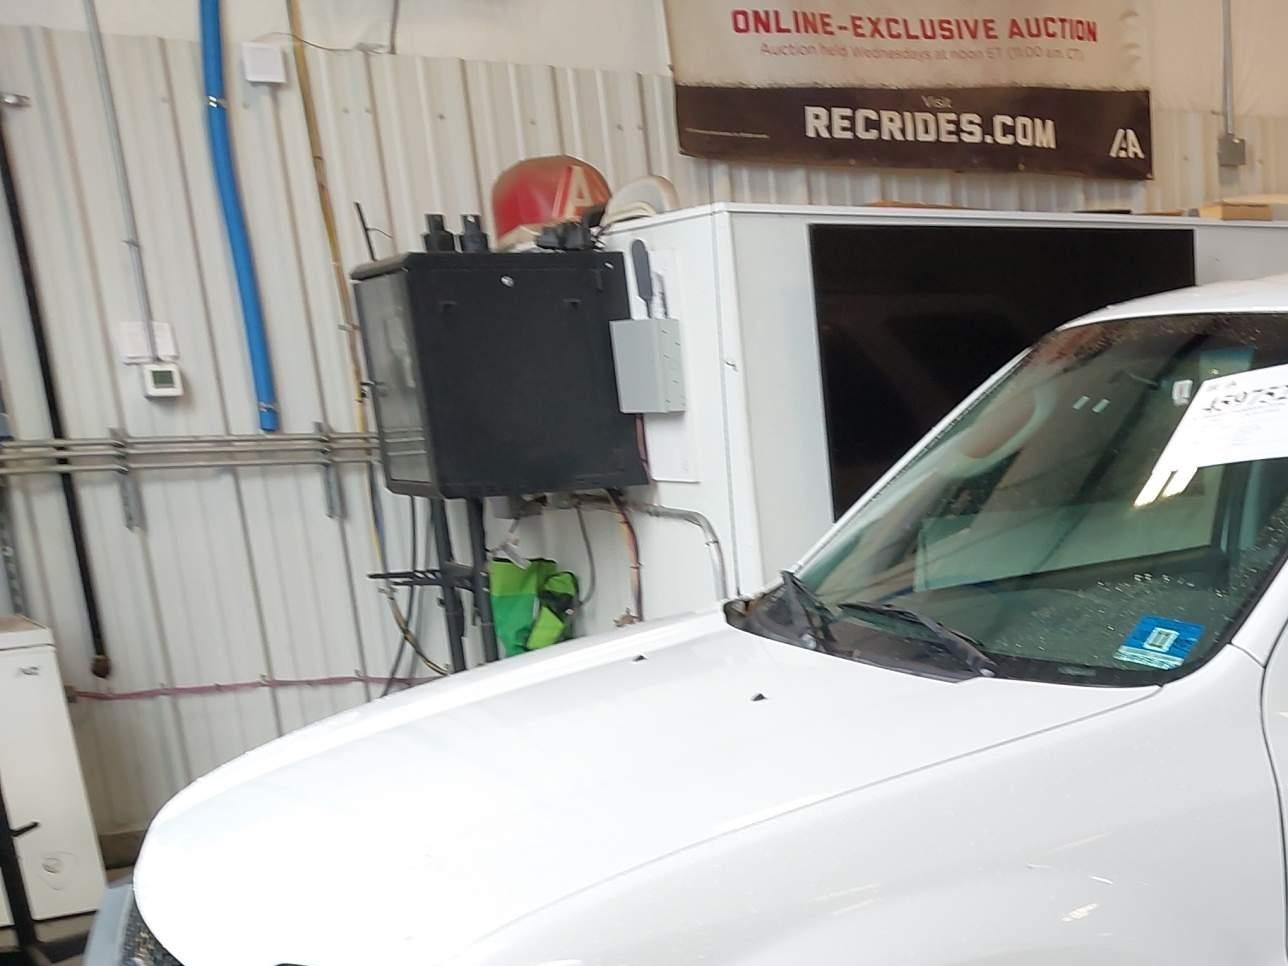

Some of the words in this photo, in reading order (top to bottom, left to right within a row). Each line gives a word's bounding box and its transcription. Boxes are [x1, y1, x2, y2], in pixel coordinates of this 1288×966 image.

[731, 9, 998, 42] ONLINE-EXCLUSIVE
[1007, 16, 1098, 43] AUCTION
[760, 43, 817, 56] Auction
[804, 105, 1057, 149] RECRIDES.COM
